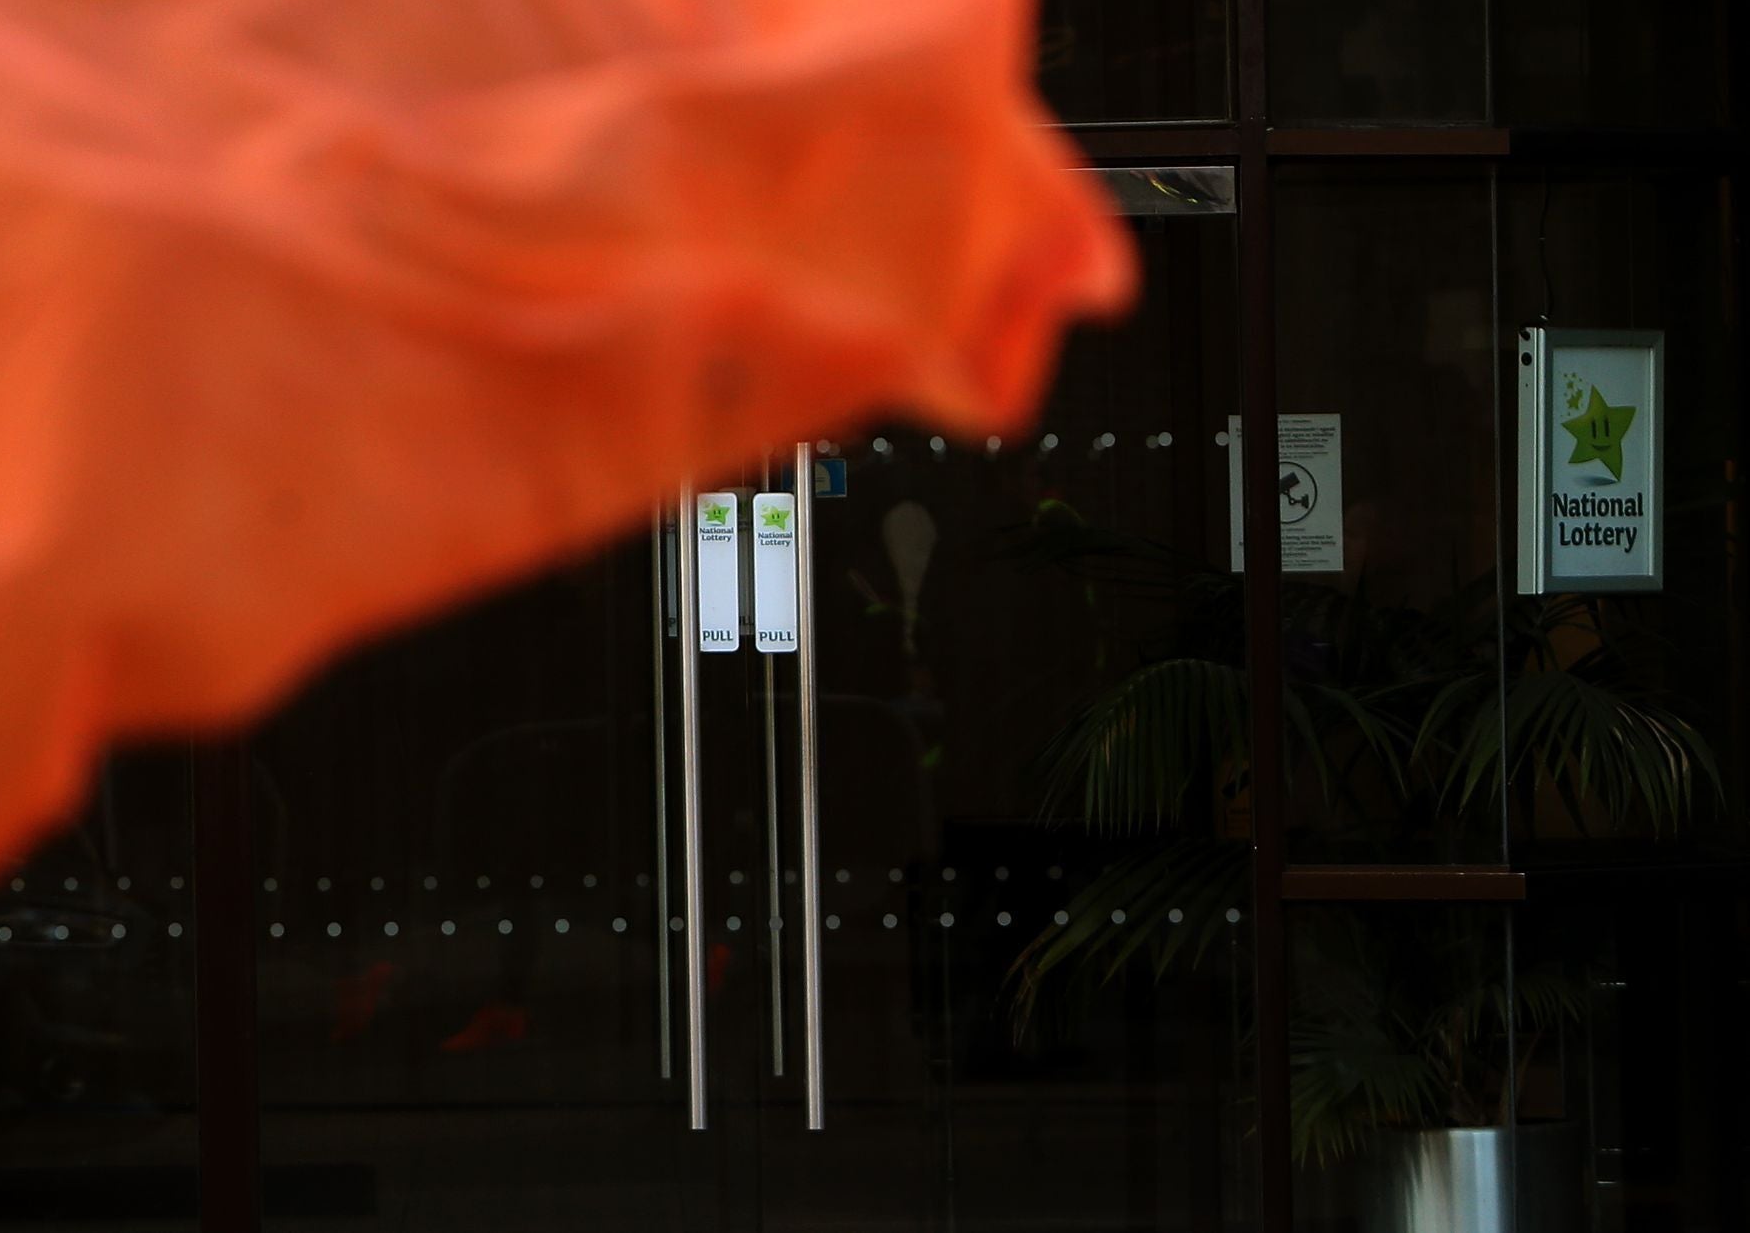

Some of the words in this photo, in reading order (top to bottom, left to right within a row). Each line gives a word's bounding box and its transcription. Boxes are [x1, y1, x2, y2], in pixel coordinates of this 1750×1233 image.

[1552, 492, 1643, 518] National
[699, 527, 734, 535] National
[757, 531, 793, 539] National
[701, 534, 732, 542] Lottery
[1559, 521, 1638, 553] Lottery
[760, 539, 791, 547] Lottery
[702, 630, 733, 642] PULL
[759, 631, 795, 642] PULL
